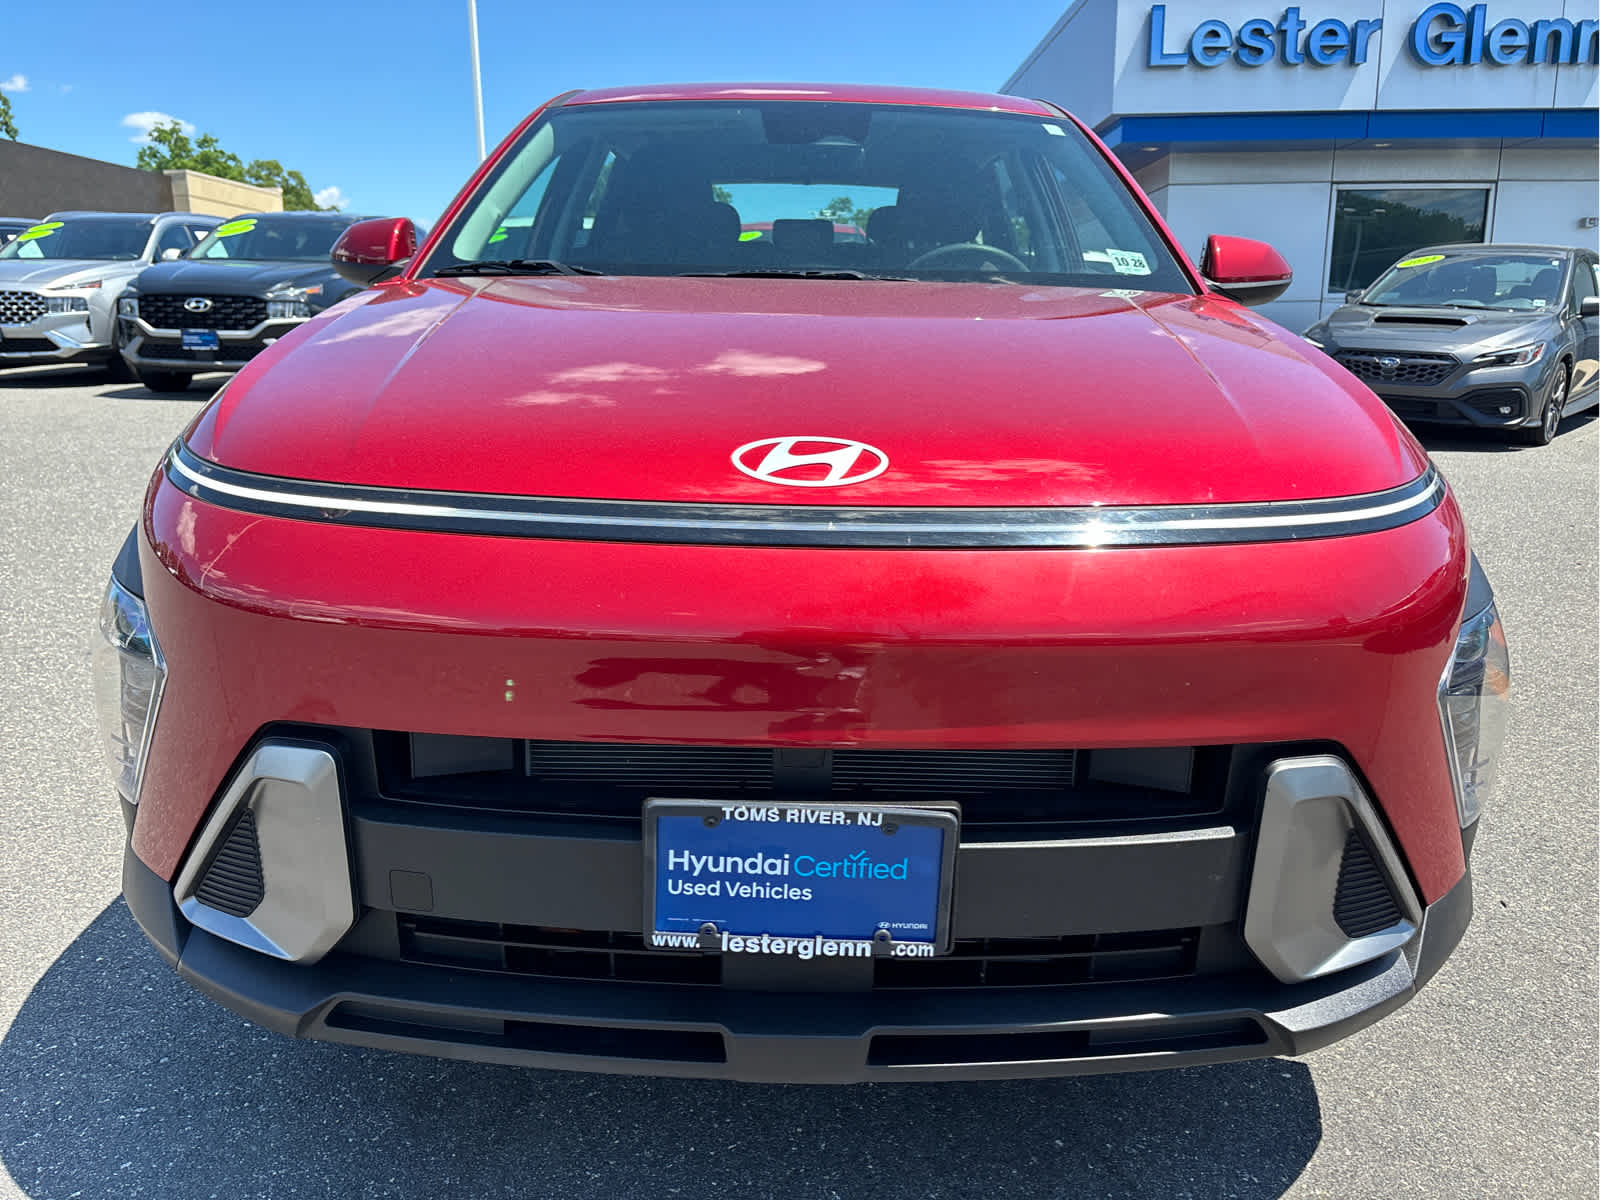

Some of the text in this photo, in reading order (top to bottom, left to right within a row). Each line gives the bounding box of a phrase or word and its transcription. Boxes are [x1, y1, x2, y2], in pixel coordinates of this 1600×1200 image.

[1148, 4, 1383, 68] Lester
[1114, 256, 1130, 267] 10
[721, 805, 884, 827] TOMS RIVER, NJ
[667, 850, 909, 881] Hyundai Certified
[667, 879, 813, 901] Used Vehicles
[891, 922, 929, 930] HYUNDAI
[651, 931, 935, 959] www. lesterglenn .com
